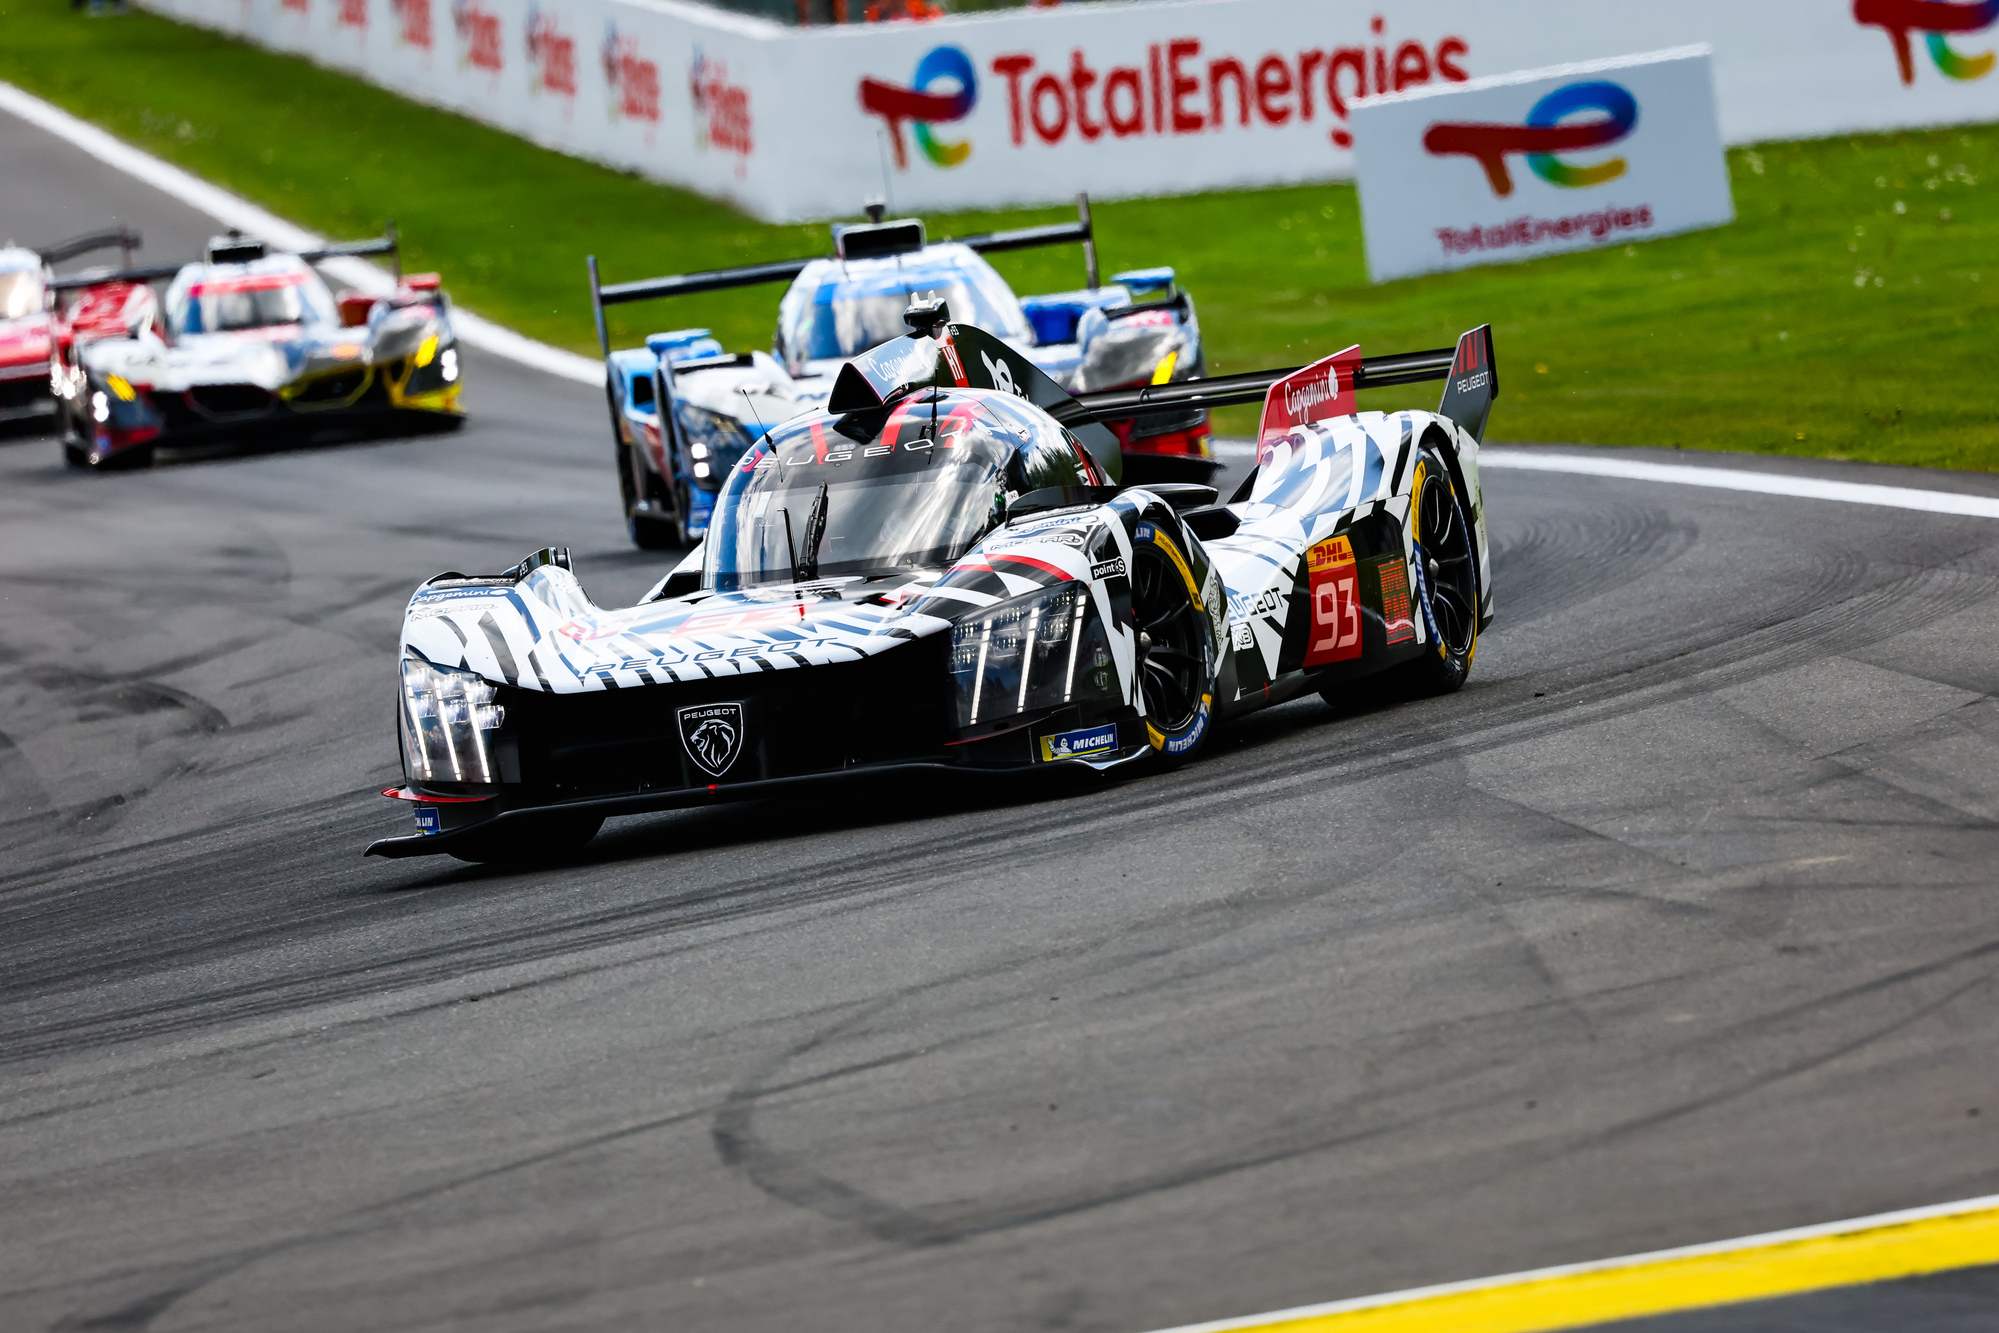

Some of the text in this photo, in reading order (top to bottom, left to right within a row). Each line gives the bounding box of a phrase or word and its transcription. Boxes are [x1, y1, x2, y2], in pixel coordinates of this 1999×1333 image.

[990, 15, 1470, 149] TotalEnergies
[1435, 204, 1655, 254] TotalEnergies
[1284, 370, 1330, 424] Capgemini
[1457, 371, 1489, 395] PEUGEOT
[741, 429, 964, 469] PEUGEOT
[1313, 541, 1349, 566] DHL
[1414, 549, 1439, 635] MICHELIN
[1313, 576, 1358, 653] 93
[584, 637, 839, 675] PEUGEOT
[684, 708, 737, 720] PEUGEOT
[1073, 733, 1114, 750] MICHELIN
[1167, 716, 1204, 752] MICHELIN
